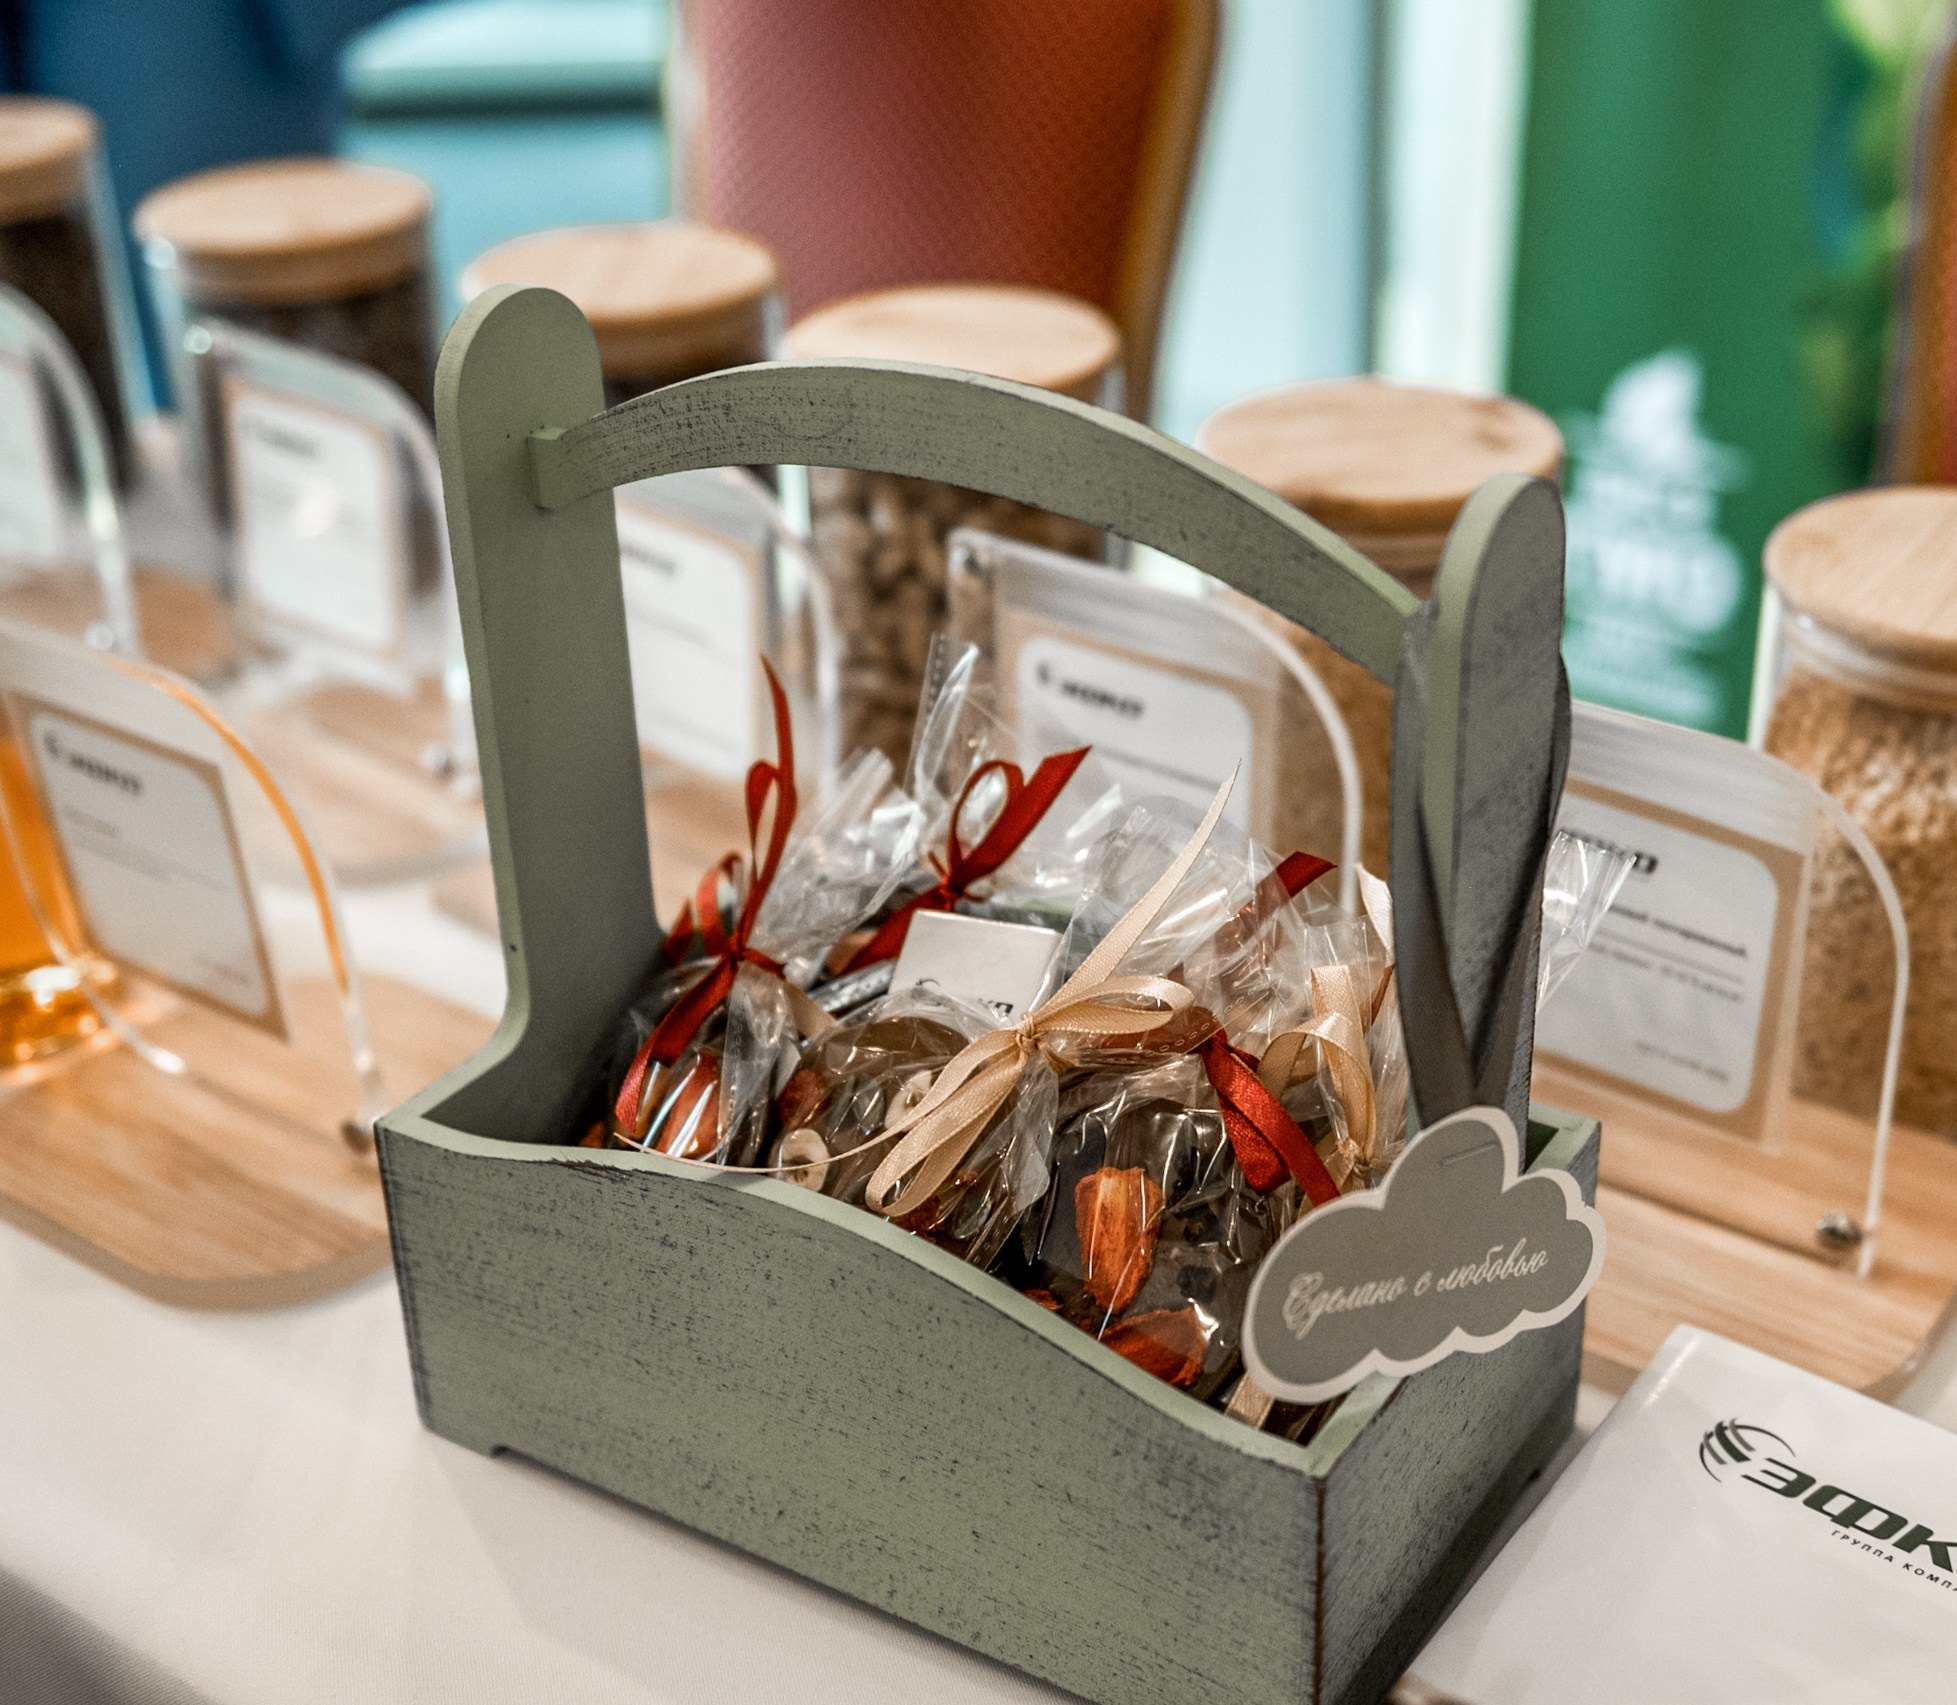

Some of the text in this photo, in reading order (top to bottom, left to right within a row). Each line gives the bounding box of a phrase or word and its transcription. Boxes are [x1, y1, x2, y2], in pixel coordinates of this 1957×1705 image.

[1282, 1271, 1408, 1340] Сделано
[1436, 1237, 1549, 1293] любовью
[1740, 1457, 1957, 1574] ЭФК
[1831, 1529, 1894, 1563] ГРУППА
